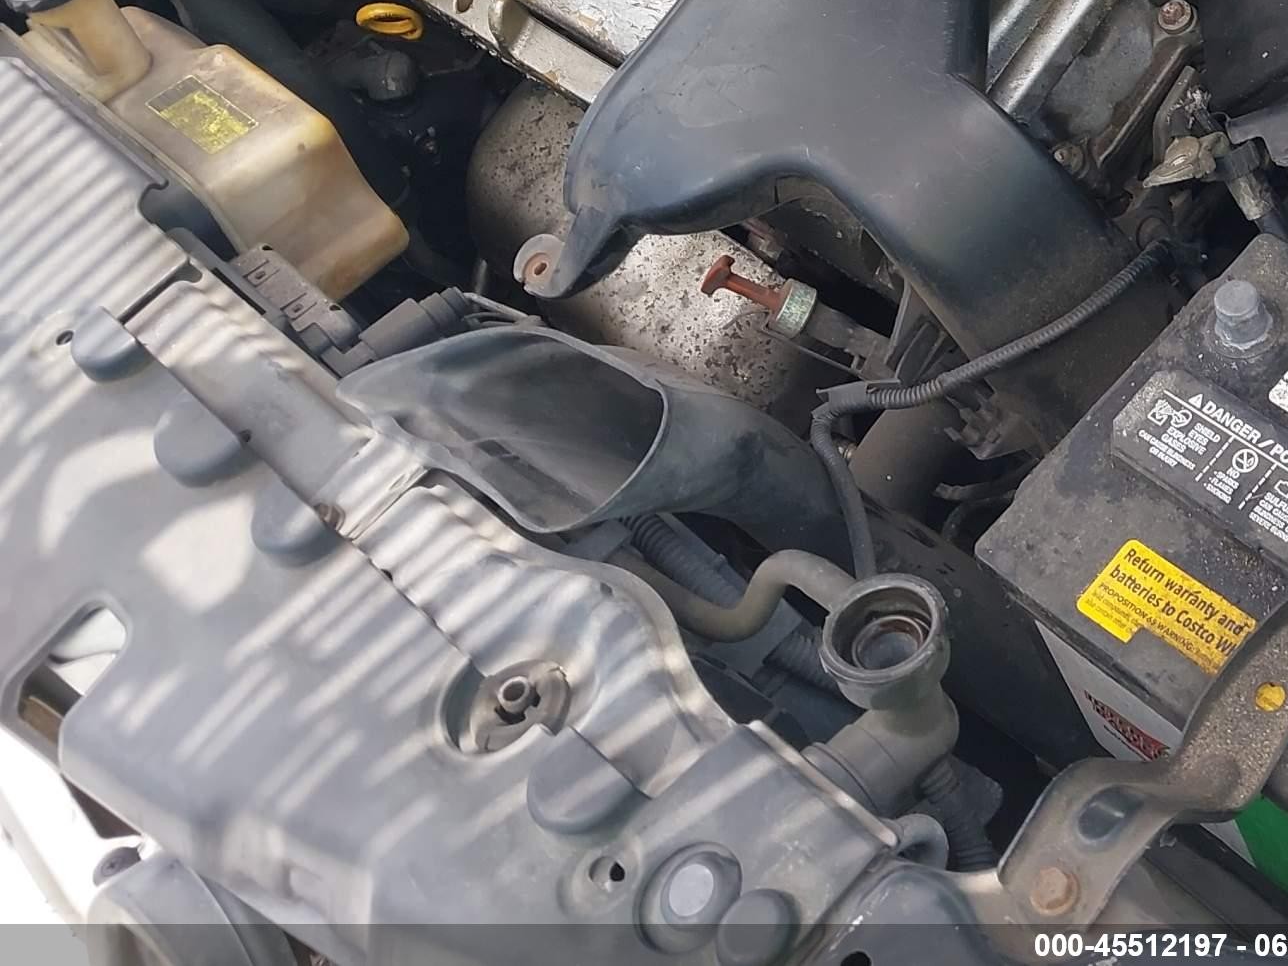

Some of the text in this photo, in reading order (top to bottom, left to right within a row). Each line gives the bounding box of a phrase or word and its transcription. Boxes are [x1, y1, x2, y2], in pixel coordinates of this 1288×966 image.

[1161, 433, 1186, 453] GASES
[1166, 426, 1207, 455] EXPLOSIVE
[1188, 429, 1209, 446] EYES
[1194, 423, 1221, 443] SHIELD
[1226, 467, 1240, 479] NO
[1109, 564, 1164, 608] batteries
[1161, 600, 1176, 616] to
[1175, 610, 1216, 644] Costco
[1124, 548, 1165, 583] Return
[1164, 578, 1220, 622] warranty
[1217, 614, 1249, 637] and
[1098, 582, 1148, 620] PROPOSITION
[1157, 622, 1194, 653] WARNING:
